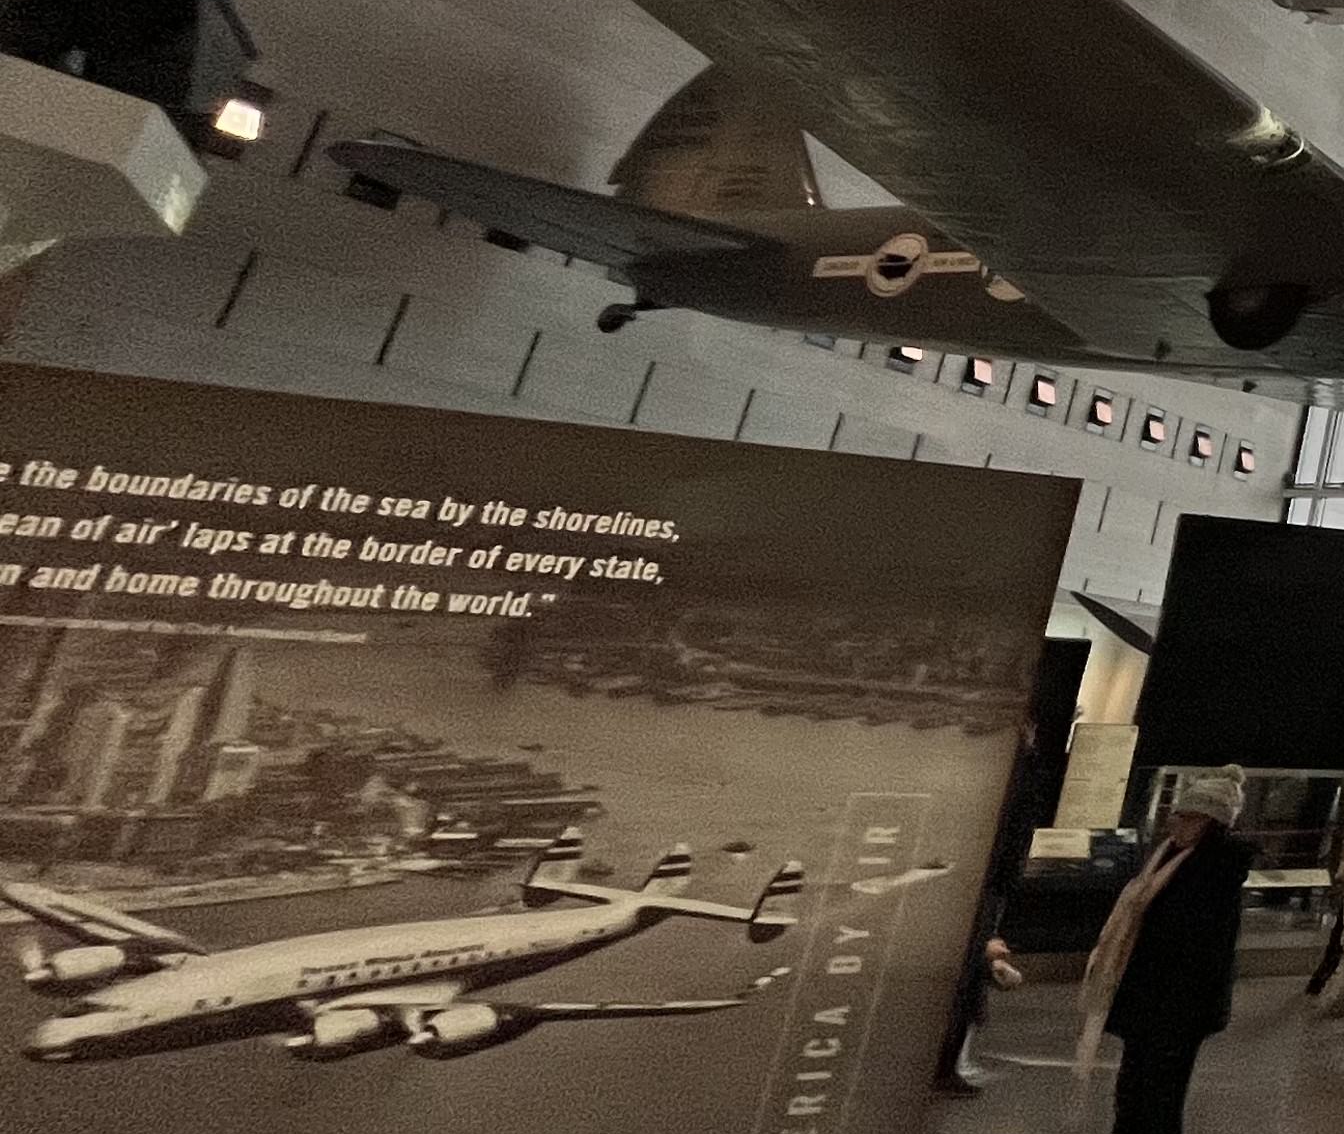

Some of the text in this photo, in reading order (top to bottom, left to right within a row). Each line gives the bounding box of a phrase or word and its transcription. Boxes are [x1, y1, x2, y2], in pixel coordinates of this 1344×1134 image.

[20, 461, 77, 489] the
[85, 466, 272, 506] boundaries
[279, 484, 317, 509] of
[321, 487, 370, 514] the
[378, 497, 430, 519] sea
[438, 496, 474, 527] by
[481, 501, 527, 526] the
[533, 506, 680, 542] shorelines,
[71, 515, 112, 541] of
[181, 522, 252, 554] laps
[259, 531, 295, 554] at
[302, 532, 351, 558] the
[359, 536, 463, 566] border
[469, 545, 504, 569] of
[506, 551, 586, 580] every
[590, 556, 664, 584] state,
[29, 564, 100, 590] and
[104, 566, 200, 596] home
[207, 572, 386, 609] throughout
[391, 585, 440, 611] the
